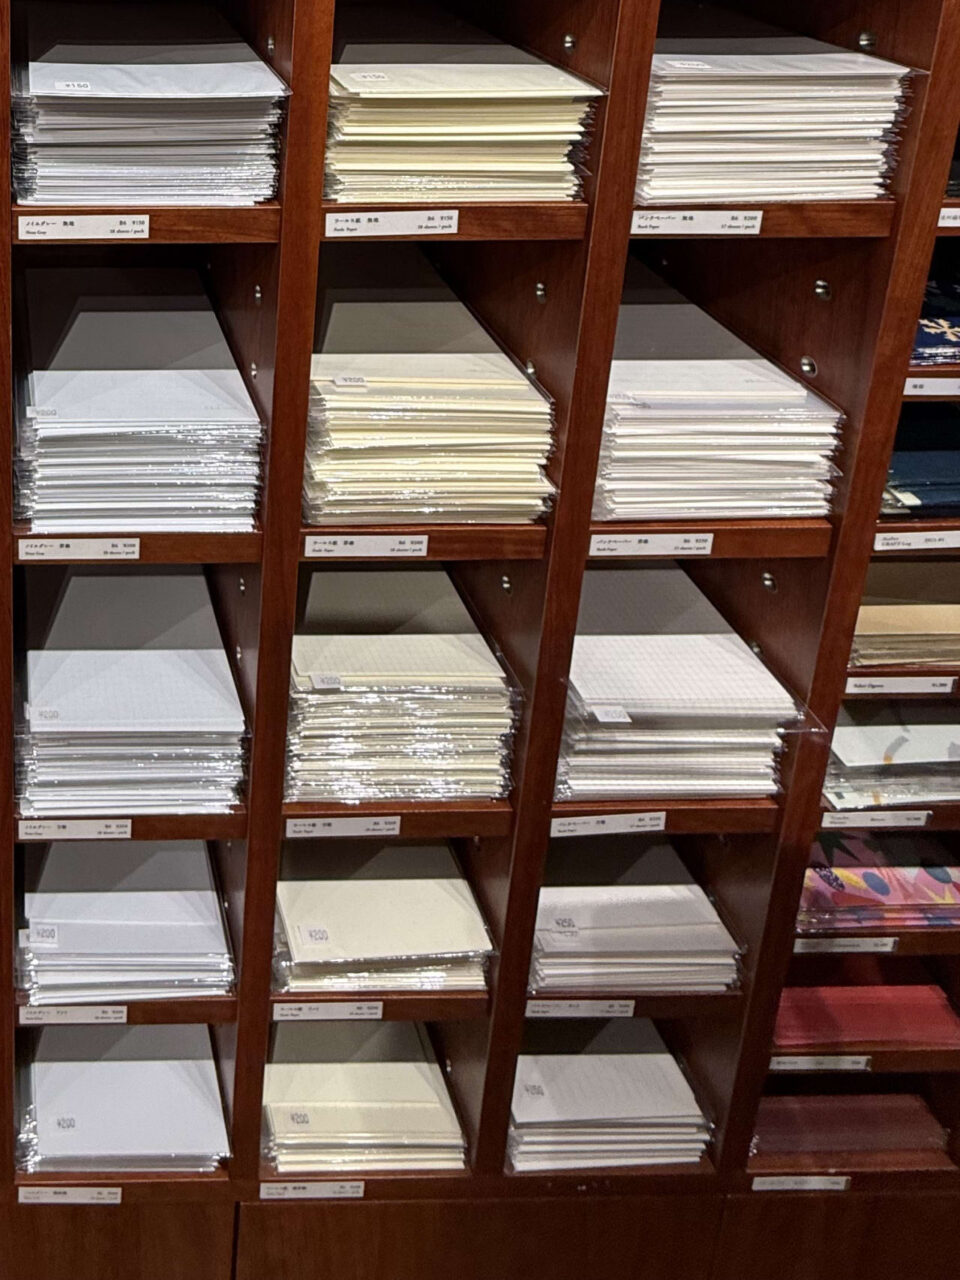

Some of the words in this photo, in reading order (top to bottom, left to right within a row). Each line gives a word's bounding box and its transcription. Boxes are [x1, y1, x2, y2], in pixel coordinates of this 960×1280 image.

[34, 928, 56, 940] ¥200
[307, 929, 329, 942] ¥200
[56, 1117, 76, 1130] ¥200
[289, 1113, 310, 1125] ¥200
